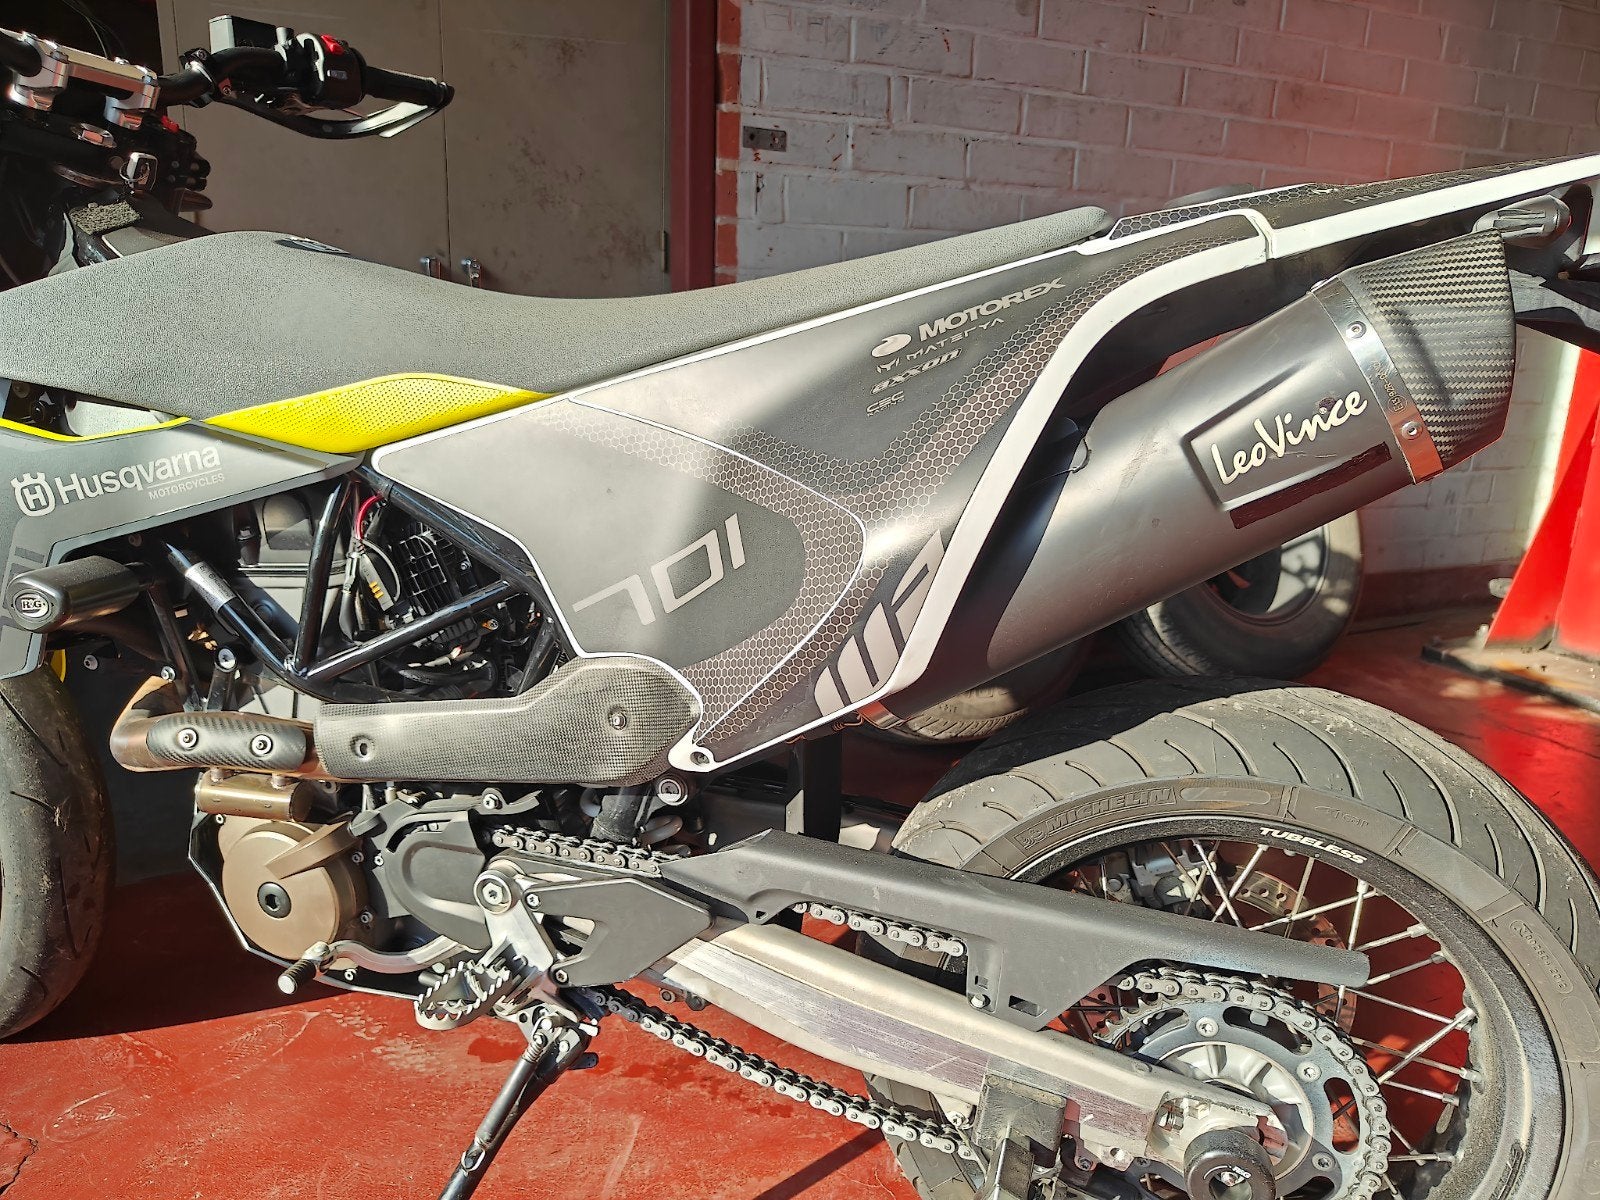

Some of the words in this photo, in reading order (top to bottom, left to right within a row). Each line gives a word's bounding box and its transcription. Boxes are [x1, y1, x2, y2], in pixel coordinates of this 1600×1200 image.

[918, 277, 1066, 341] MOTOREX
[1210, 390, 1368, 485] LeoVince
[55, 446, 220, 504] Husqvarna
[148, 473, 225, 500] MOTORCYCLES
[572, 513, 746, 626] 701
[1045, 787, 1175, 831] MICHELIN
[1260, 827, 1368, 864] TUBELESS
